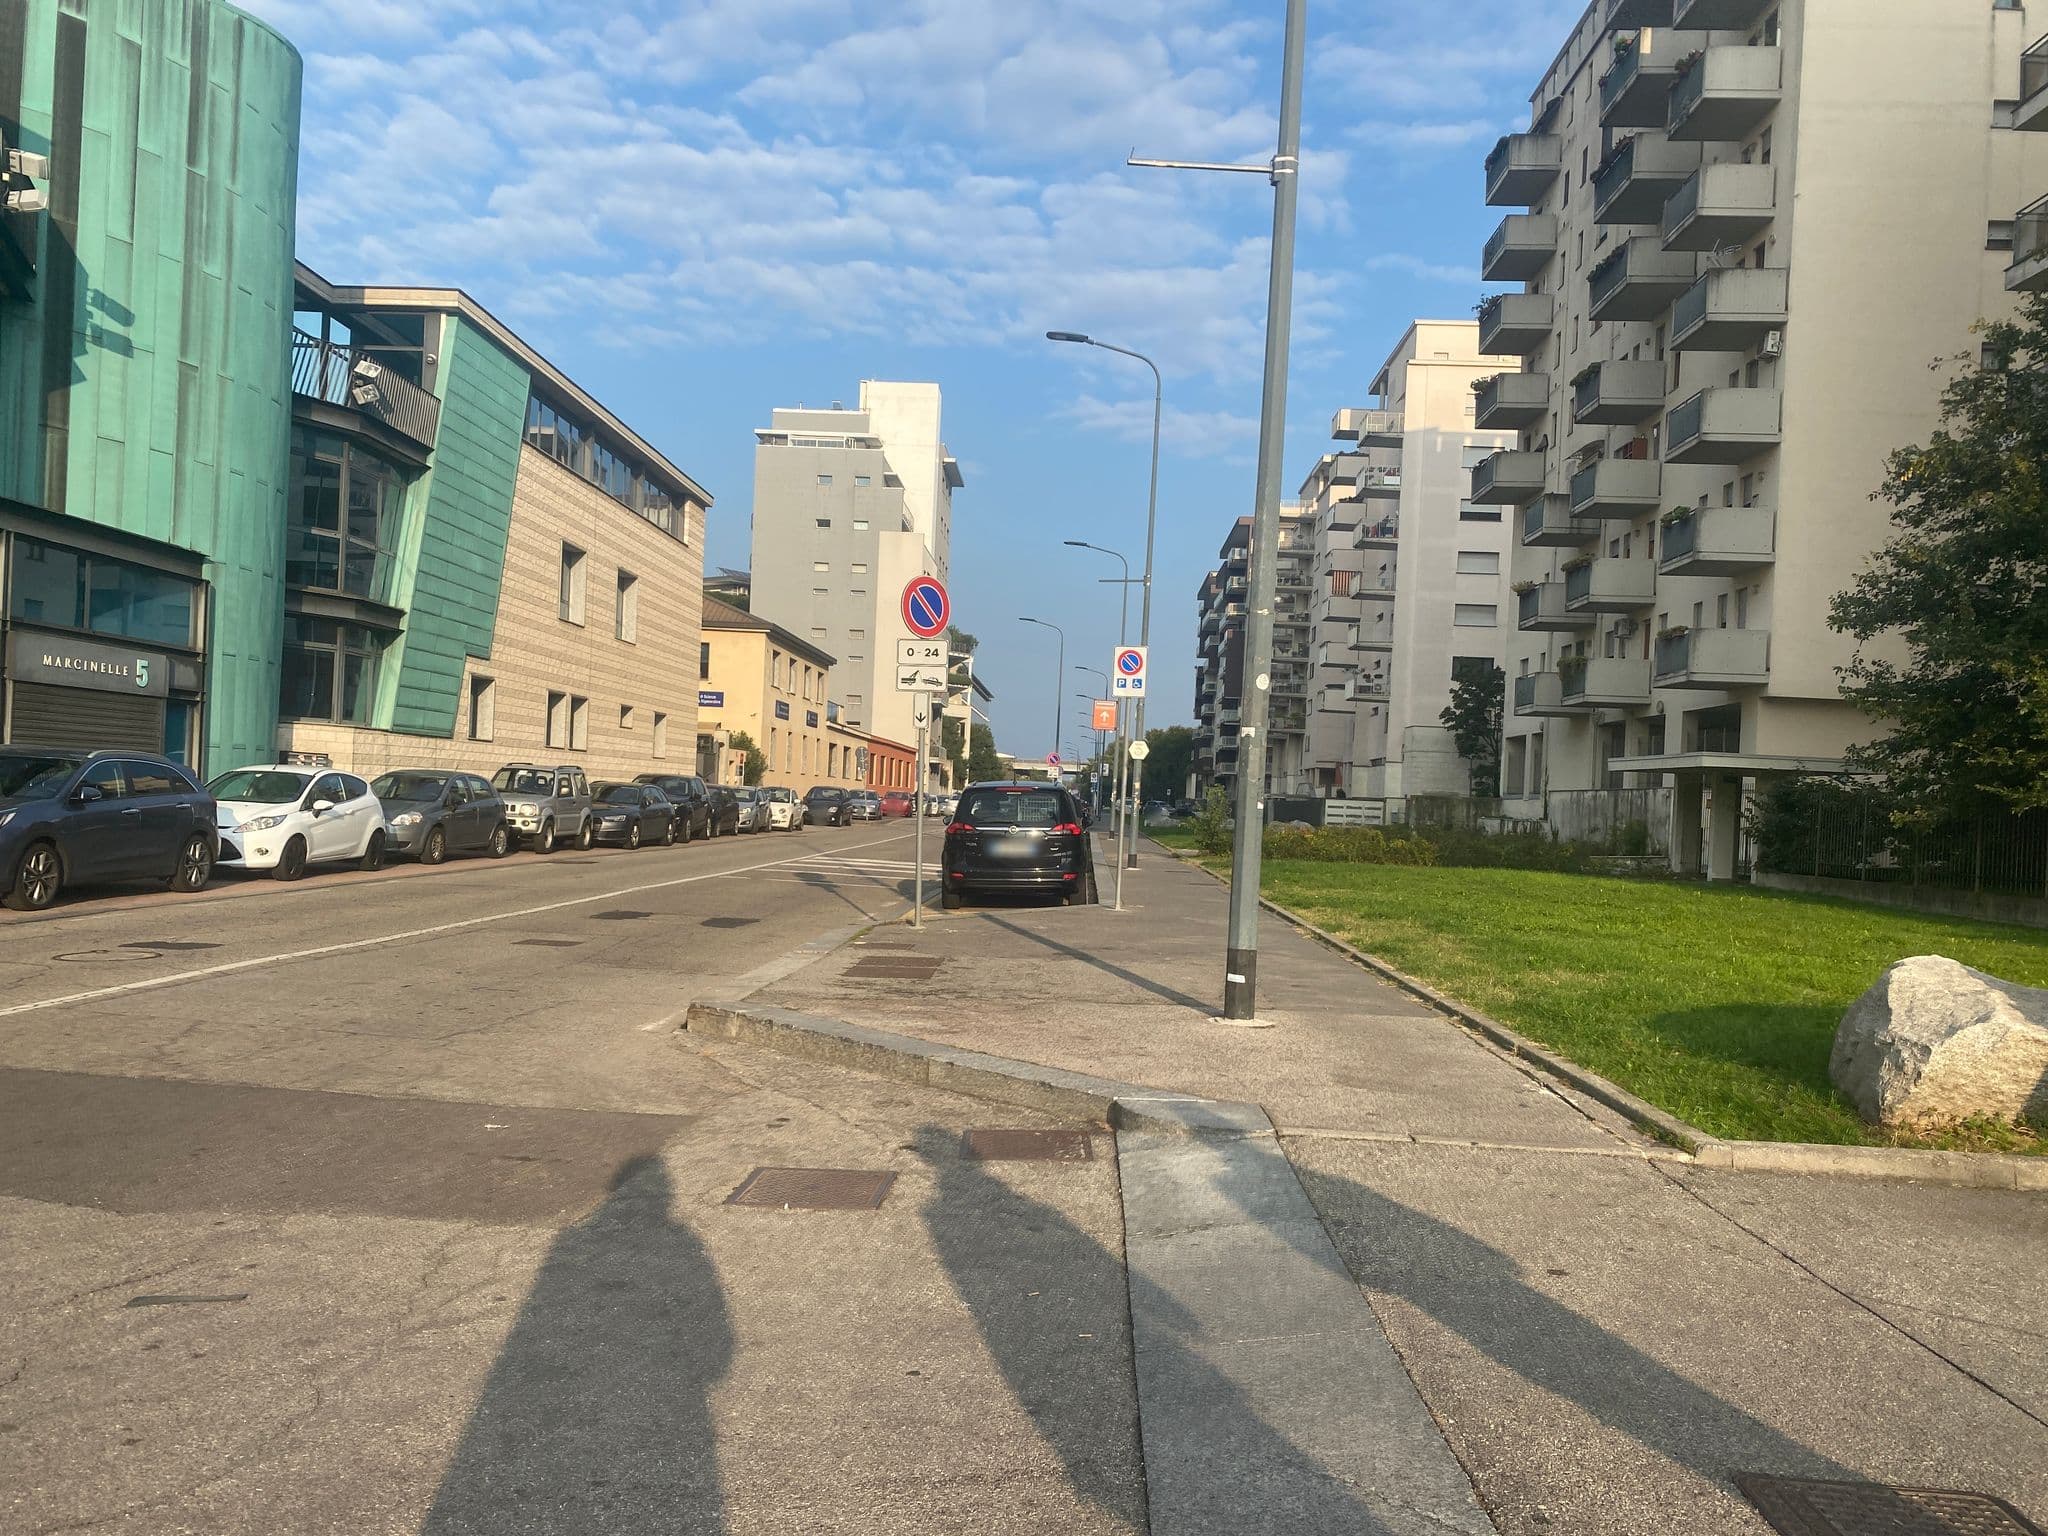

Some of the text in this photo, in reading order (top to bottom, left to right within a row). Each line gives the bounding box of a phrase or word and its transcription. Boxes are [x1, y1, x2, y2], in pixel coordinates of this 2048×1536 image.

[907, 648, 914, 656] 0
[924, 648, 939, 657] 24
[43, 655, 149, 687] MARCINELLE 5
